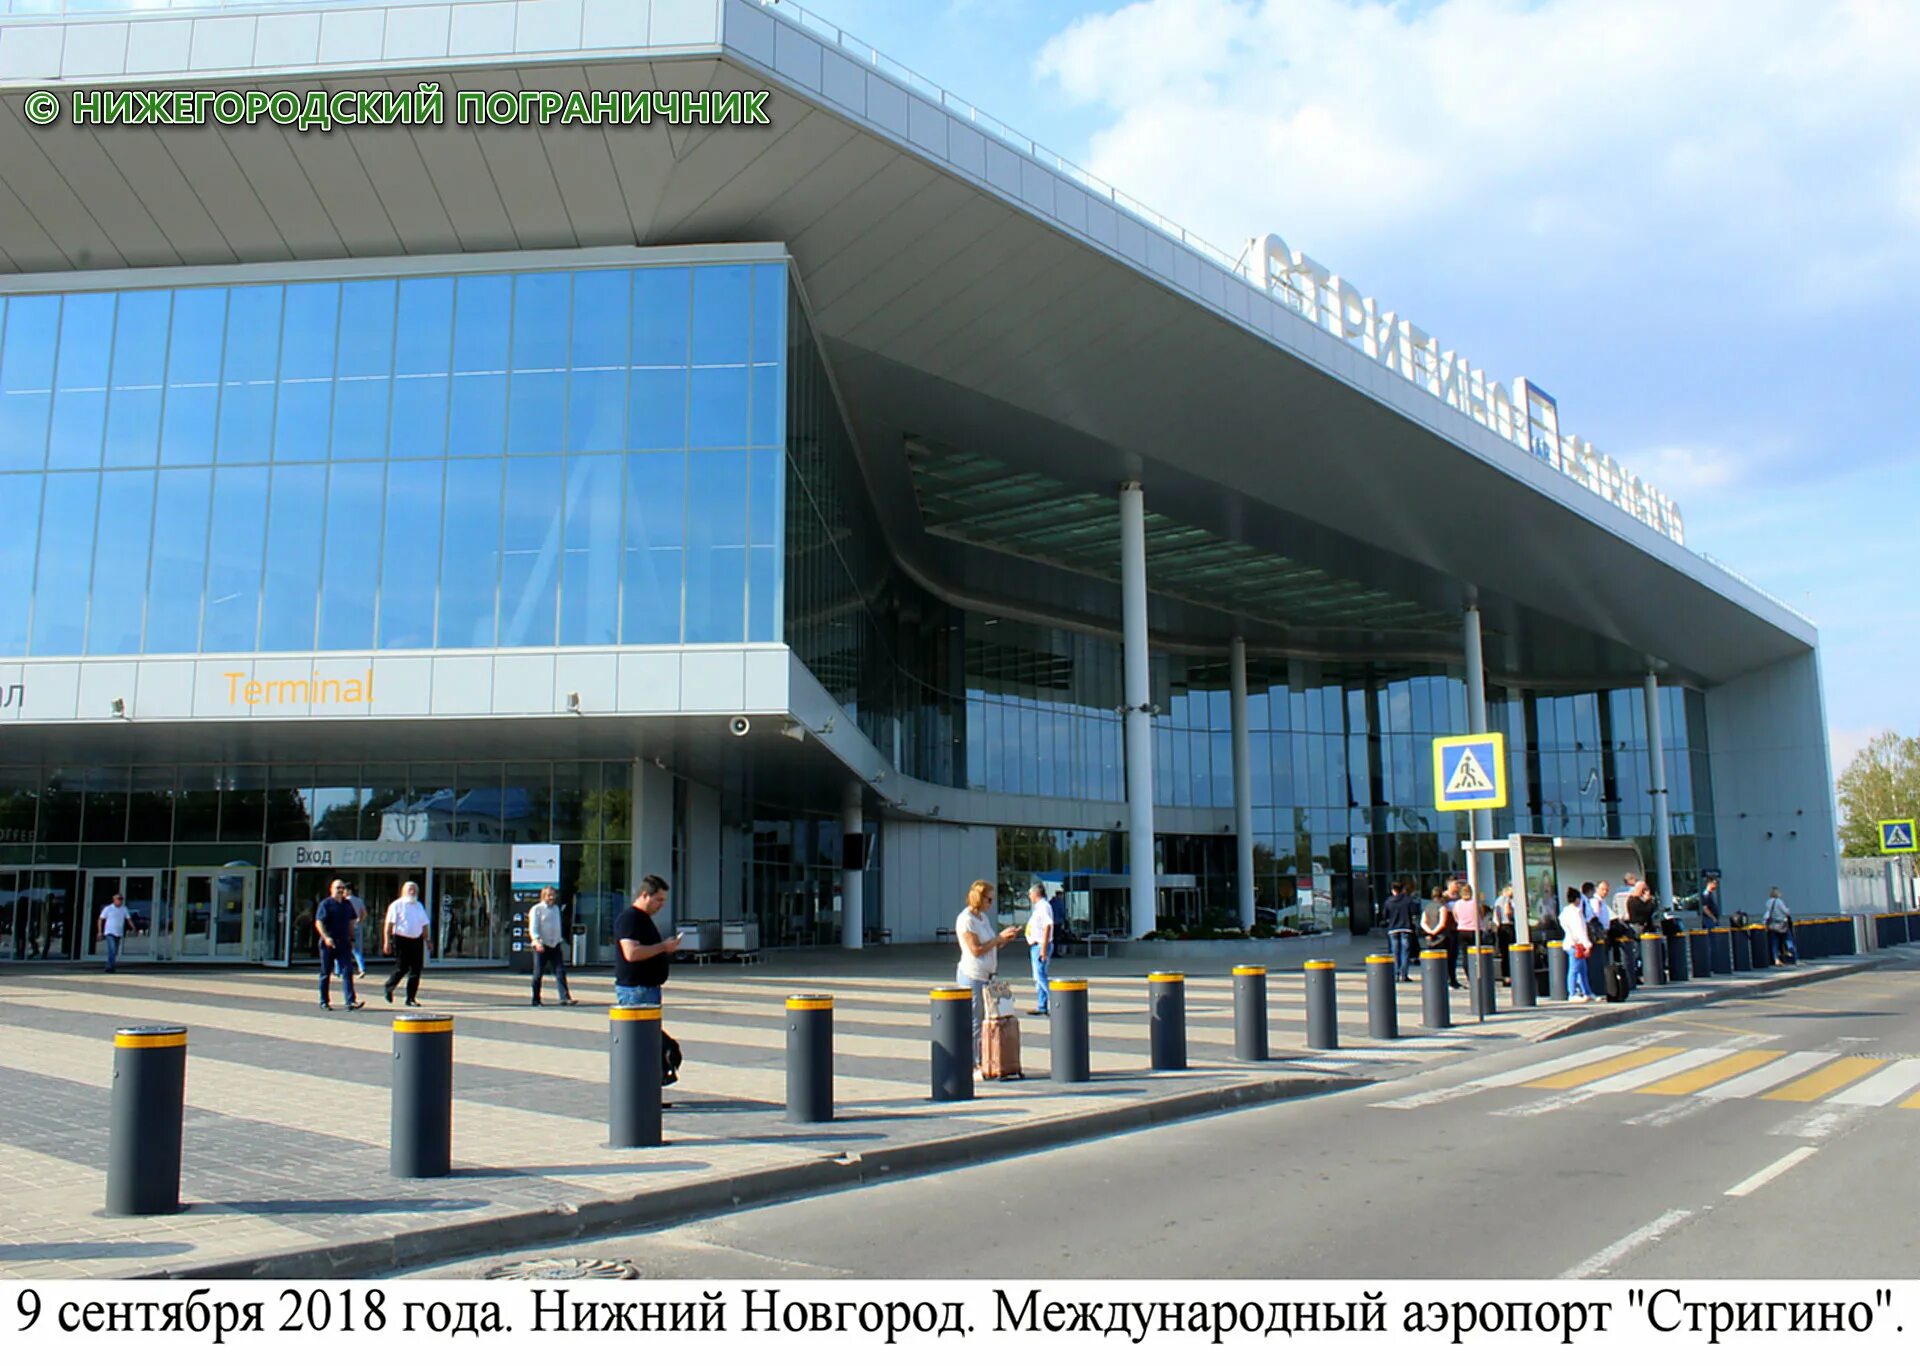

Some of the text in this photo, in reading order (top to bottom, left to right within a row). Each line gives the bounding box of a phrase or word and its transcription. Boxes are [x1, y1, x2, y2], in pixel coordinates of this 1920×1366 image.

[1254, 233, 1514, 441] СТРИГИНО
[223, 669, 374, 705] Terminal
[297, 847, 332, 865] Вход
[342, 846, 421, 865] Entrance
